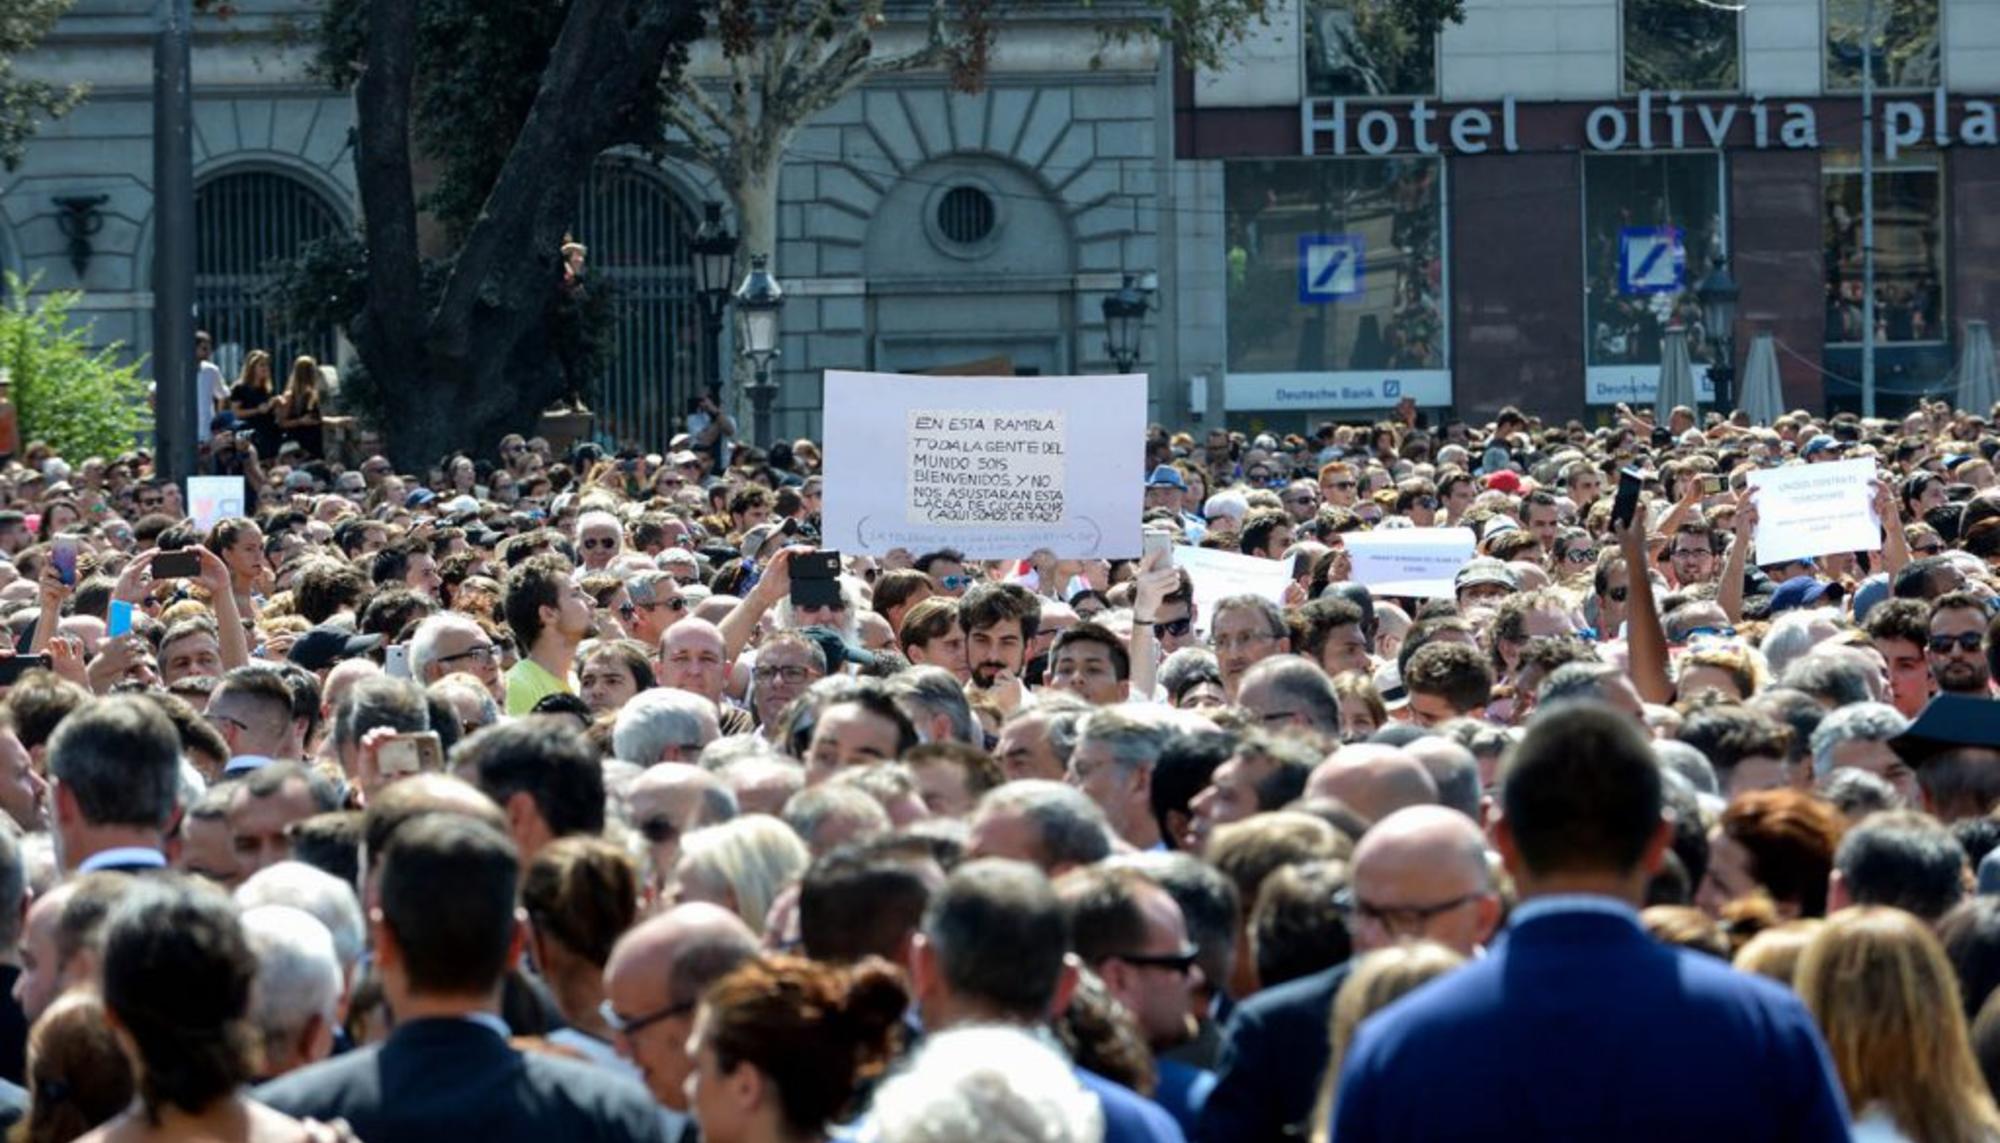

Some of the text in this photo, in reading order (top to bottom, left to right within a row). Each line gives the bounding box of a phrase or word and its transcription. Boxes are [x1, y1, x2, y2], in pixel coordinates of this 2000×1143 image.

[1302, 85, 2000, 161] Hotel olivia pla
[1276, 386, 1375, 400] Deutsche Bank
[915, 416, 1055, 432] EN ESTA RAMBLA
[913, 437, 1064, 455] TODA LA GENTE DEL
[913, 454, 1009, 471] MUNDO SOIS
[1016, 474, 1029, 487] Y
[1031, 475, 1051, 488] NO
[913, 486, 1063, 501] NOS ASUSTARAN ESTA
[913, 498, 963, 510] LACRA
[968, 500, 984, 510] DE
[972, 509, 1008, 521] SOMOS
[1010, 510, 1024, 521] DE
